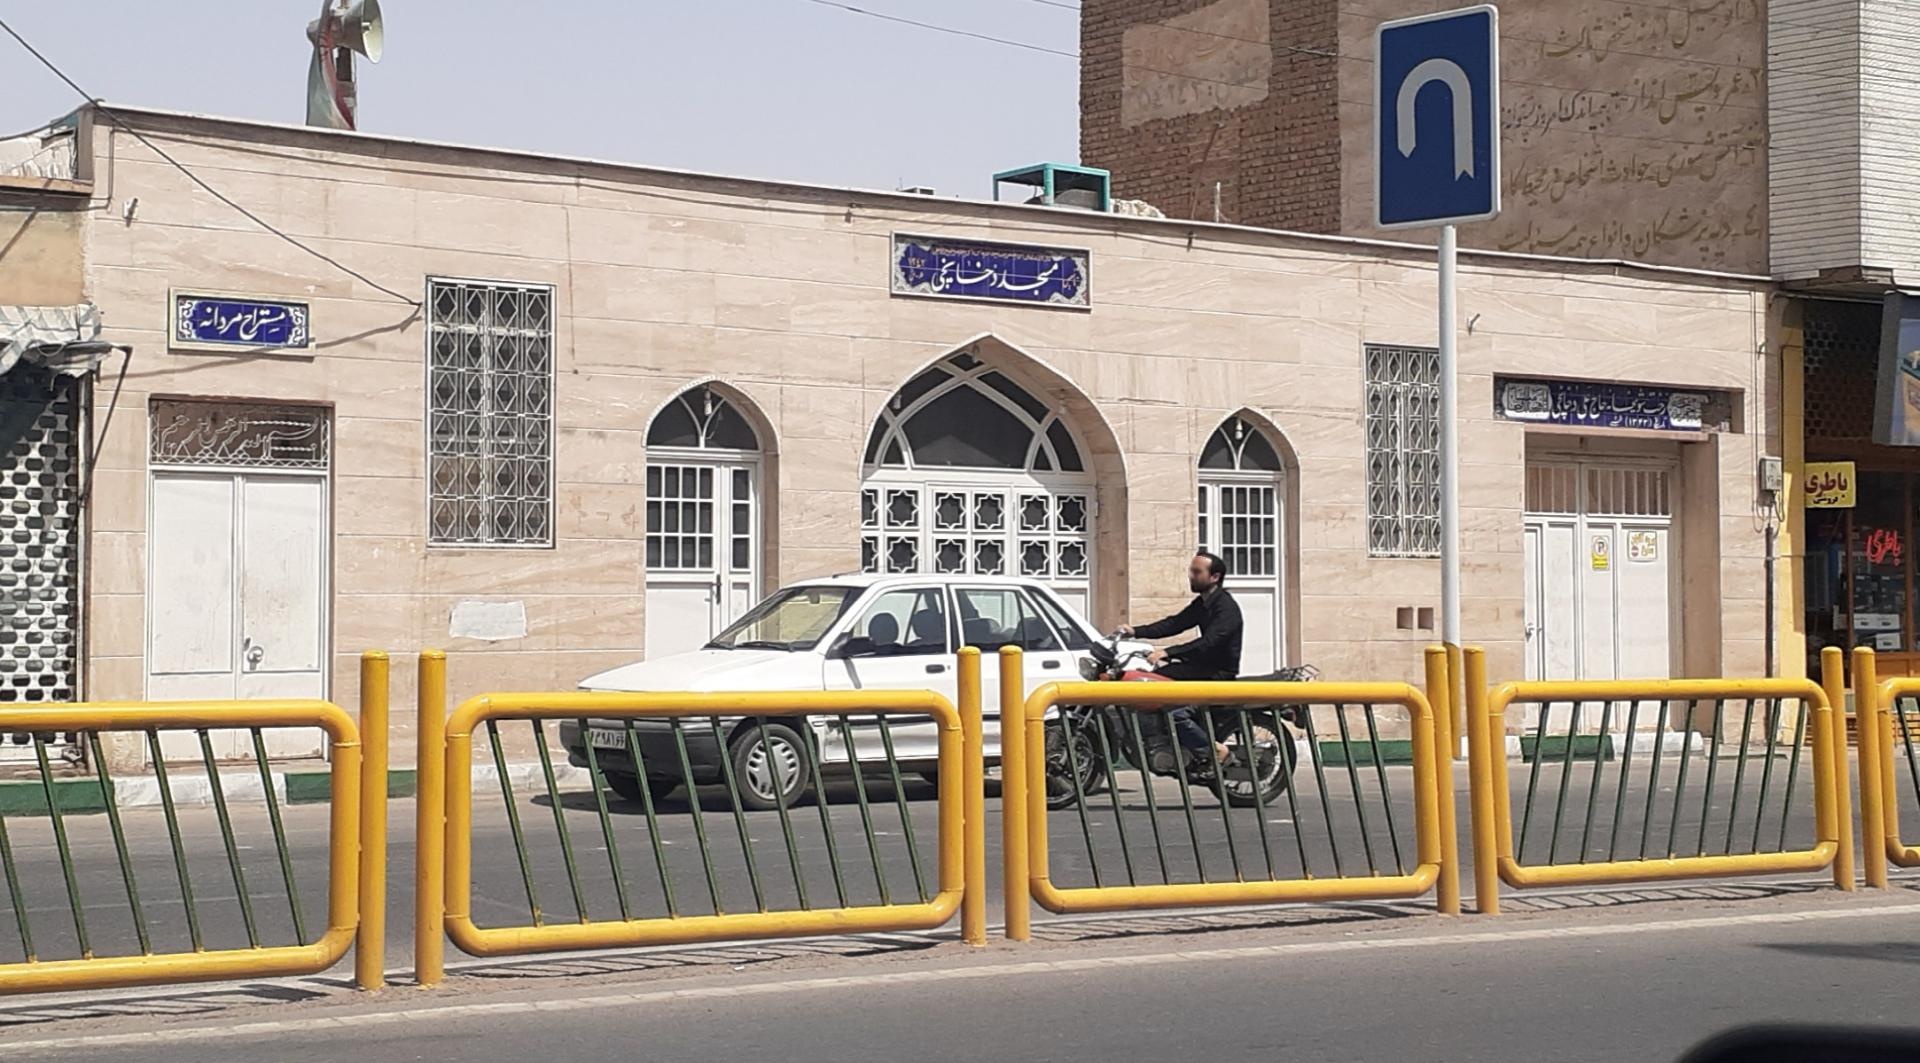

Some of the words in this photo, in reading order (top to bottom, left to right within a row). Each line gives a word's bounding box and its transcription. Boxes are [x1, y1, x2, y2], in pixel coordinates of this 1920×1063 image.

[998, 262, 1058, 296] مسجد
[200, 306, 243, 335] مردانه
[239, 307, 286, 340] مستراح
[1804, 471, 1848, 498] باطری
[1865, 529, 1901, 567] باطری
